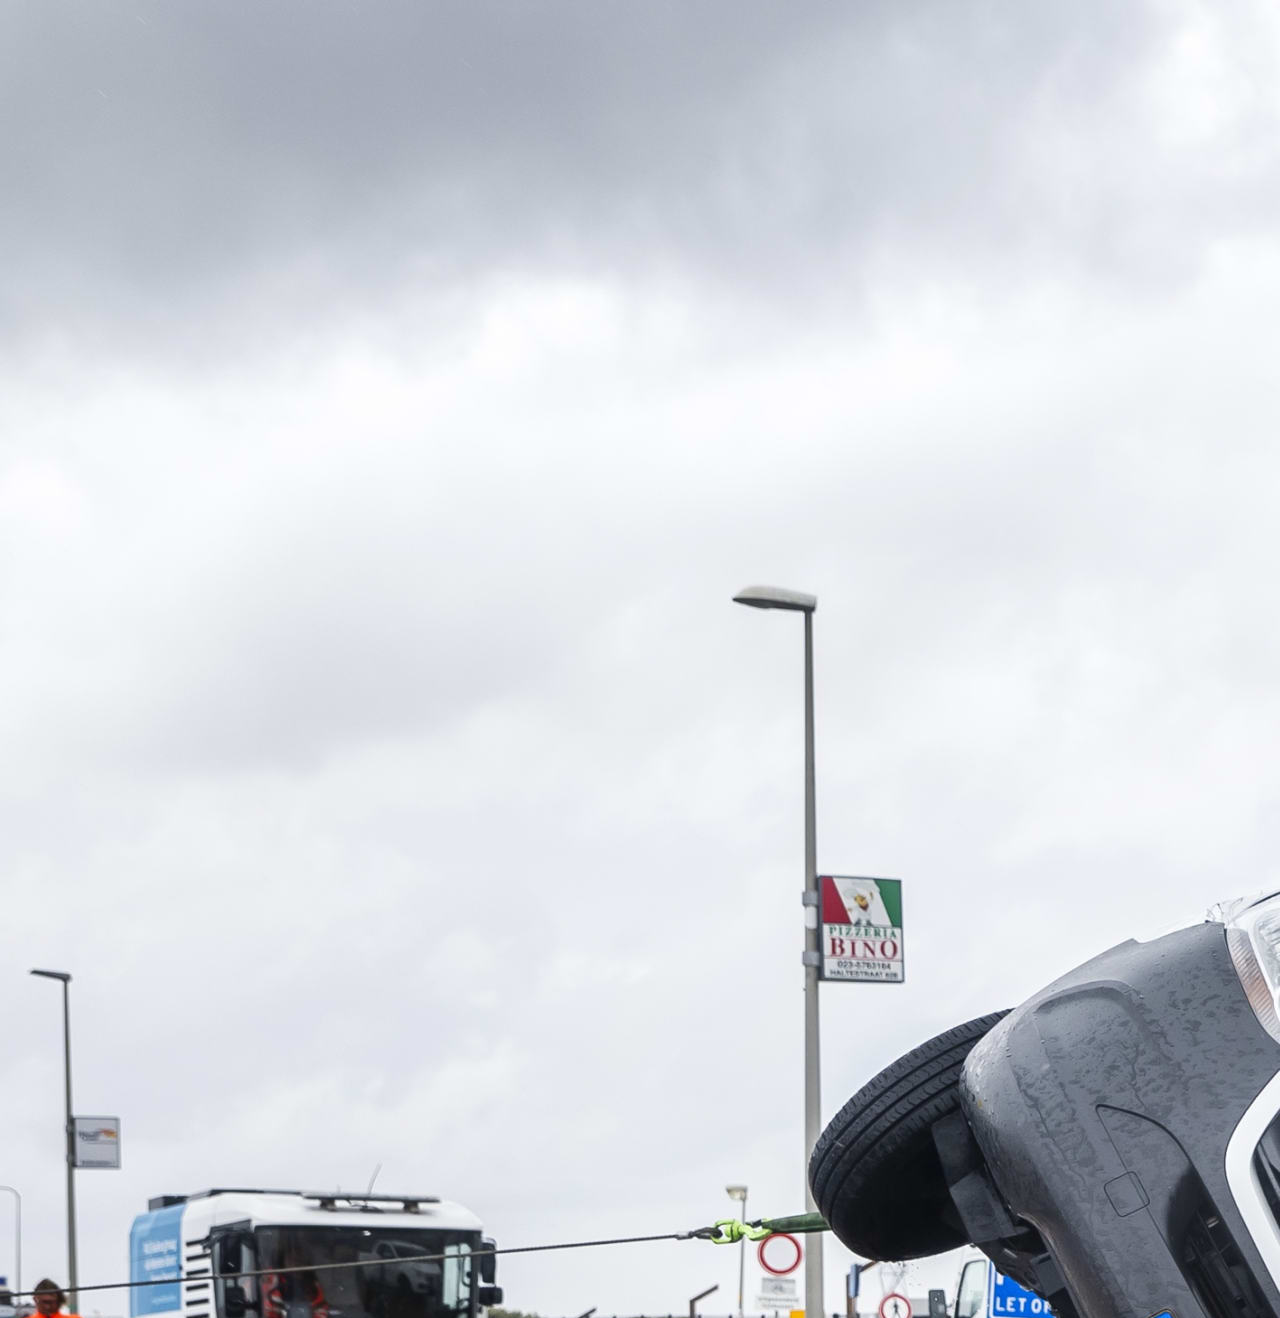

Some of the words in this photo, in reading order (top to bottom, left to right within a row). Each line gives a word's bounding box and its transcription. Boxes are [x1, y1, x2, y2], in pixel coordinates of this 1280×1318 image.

[828, 926, 897, 938] PIZZERIA
[830, 937, 898, 960] BINO
[996, 1296, 1027, 1313] LET
